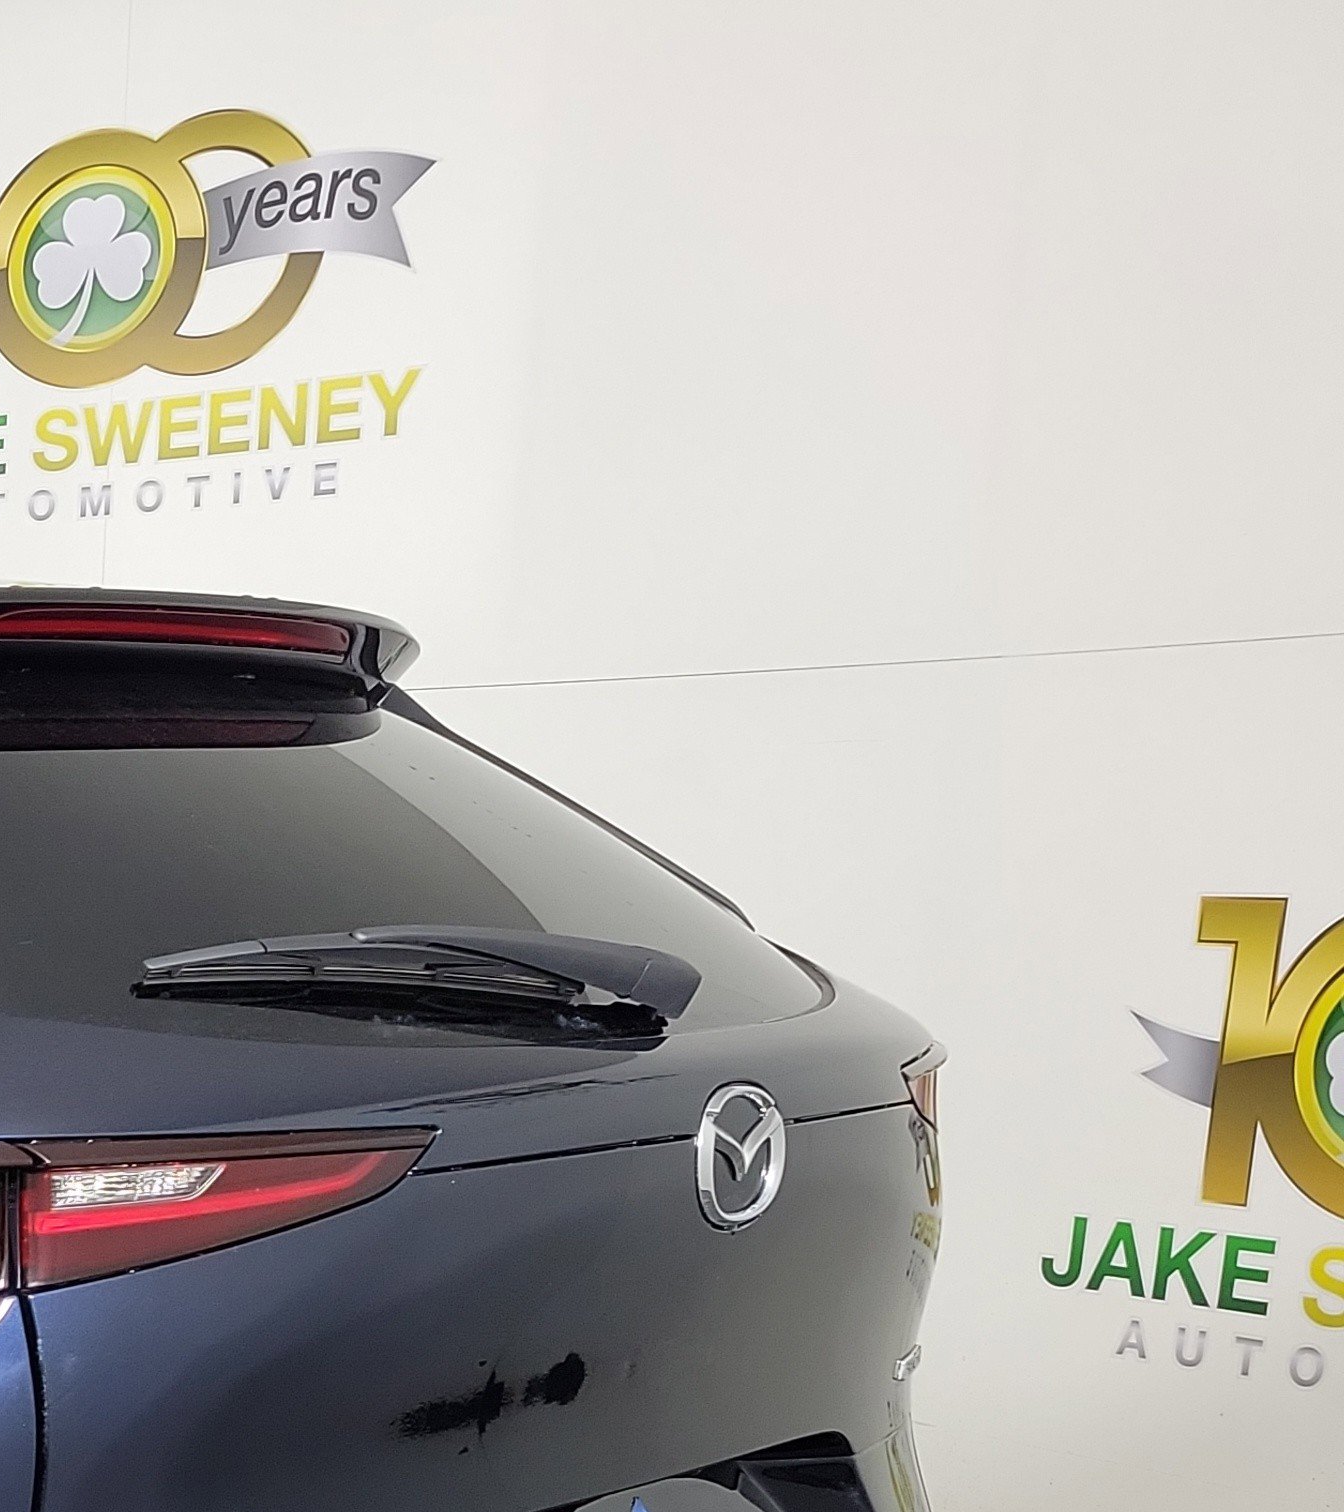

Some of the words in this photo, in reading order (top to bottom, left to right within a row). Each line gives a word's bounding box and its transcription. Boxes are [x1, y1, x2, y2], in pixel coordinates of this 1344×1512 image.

[218, 164, 383, 256] years
[31, 367, 423, 473] SWEENEY
[1040, 1216, 1278, 1317] JAKE
